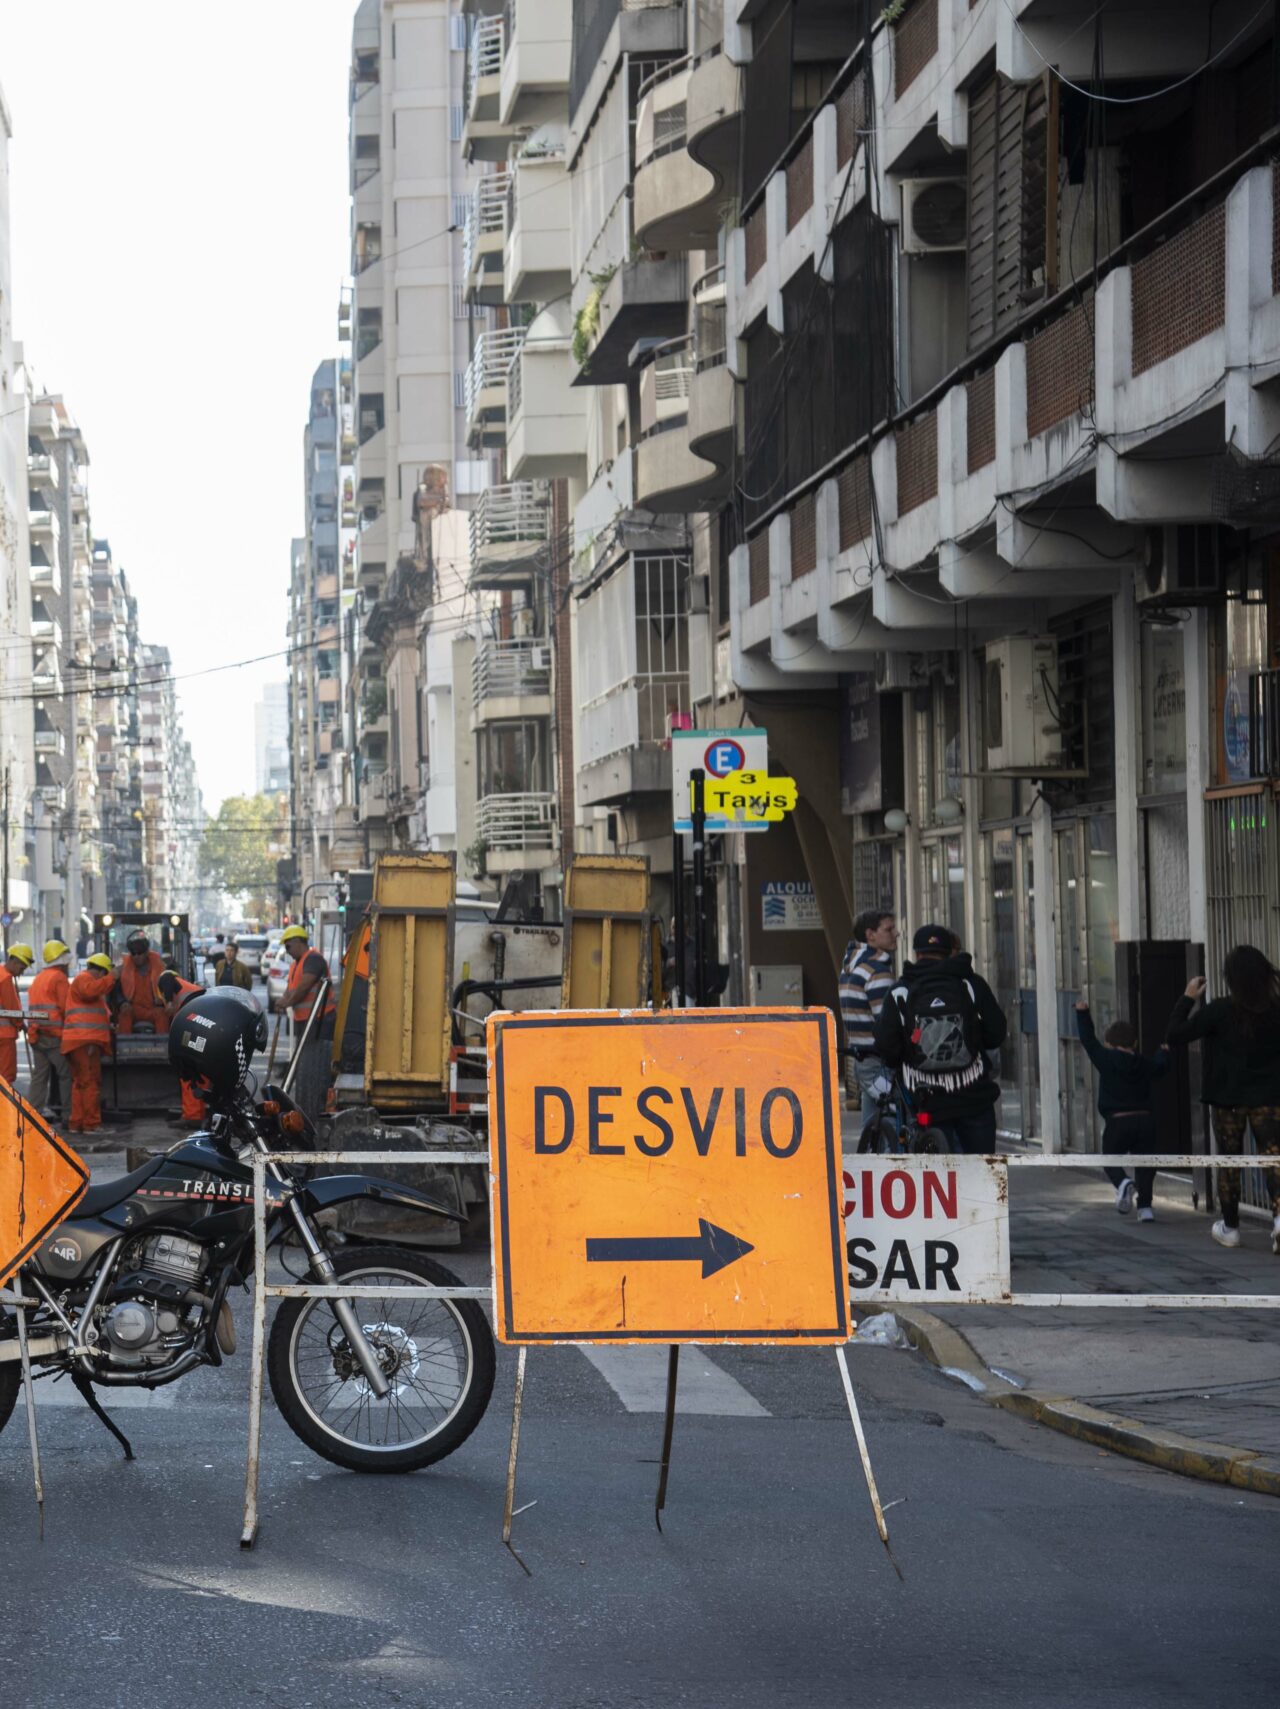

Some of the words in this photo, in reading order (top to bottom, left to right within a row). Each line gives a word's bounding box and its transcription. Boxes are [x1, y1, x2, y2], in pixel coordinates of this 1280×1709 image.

[716, 747, 733, 772] E
[740, 773, 757, 784] 3
[713, 791, 788, 808] Taxis
[766, 882, 811, 894] ALQUI
[534, 1086, 804, 1159] DESVIO
[182, 1180, 274, 1200] TRANSI
[54, 1246, 76, 1262] MR
[847, 1238, 962, 1291] SAR
